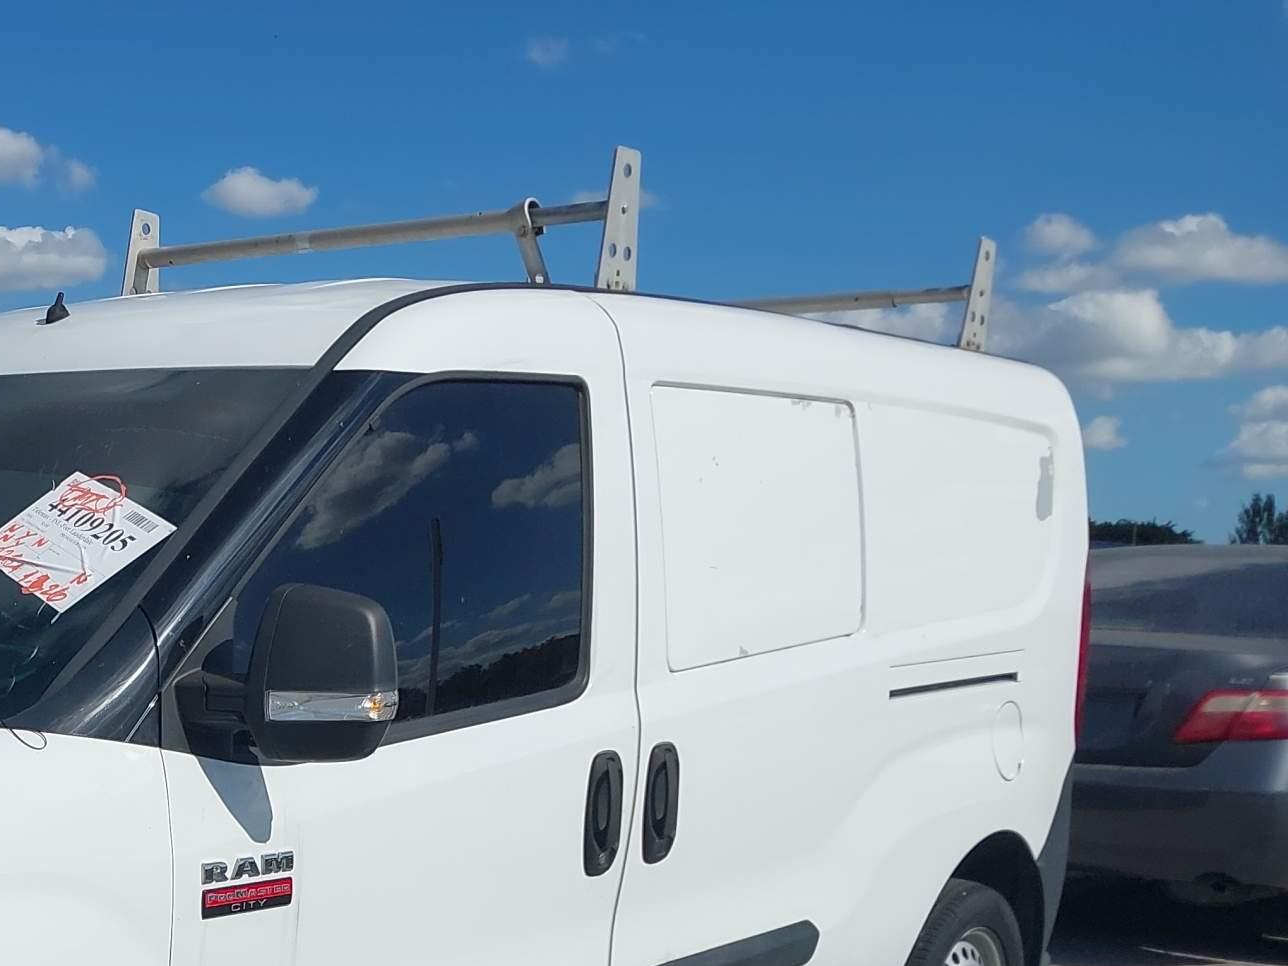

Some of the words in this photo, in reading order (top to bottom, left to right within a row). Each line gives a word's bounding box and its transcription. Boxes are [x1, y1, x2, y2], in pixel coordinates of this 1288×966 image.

[48, 500, 136, 551] 44109205
[201, 850, 294, 885] RAM
[231, 899, 267, 912] CITY
